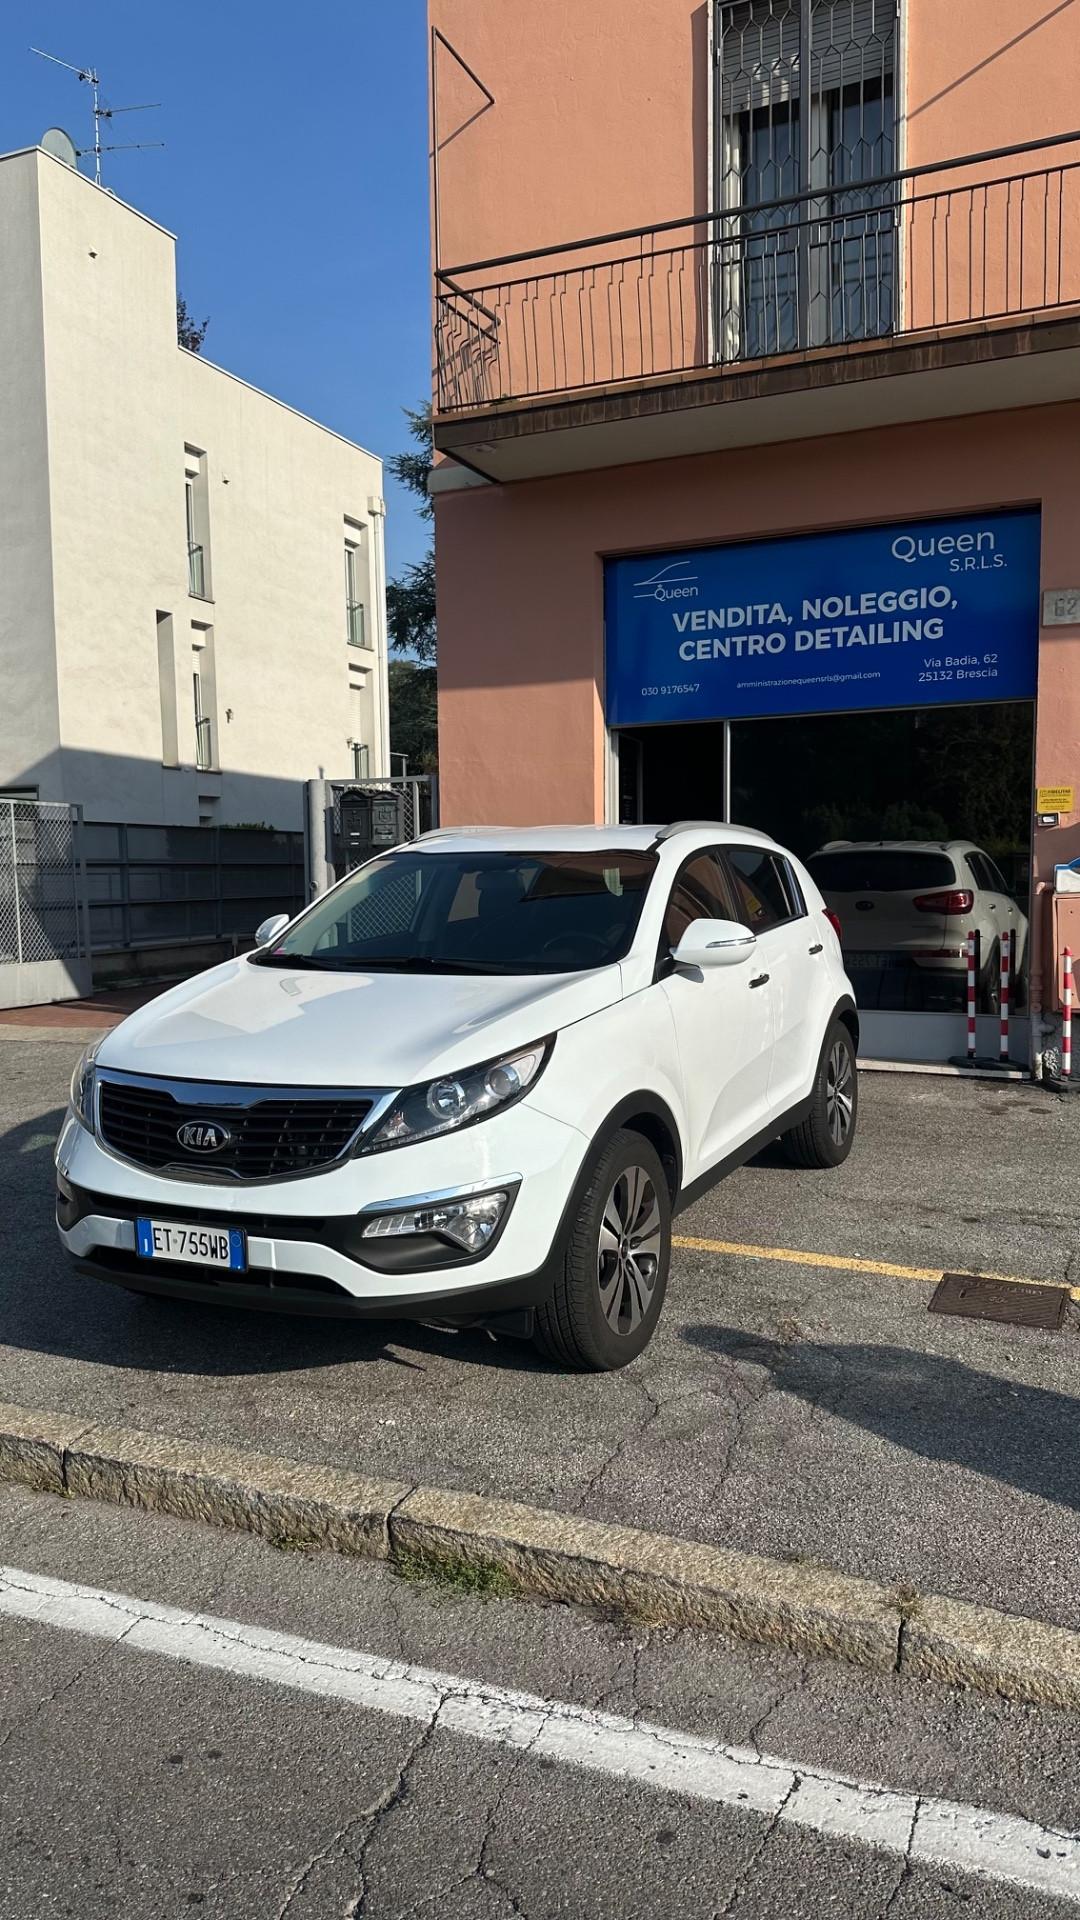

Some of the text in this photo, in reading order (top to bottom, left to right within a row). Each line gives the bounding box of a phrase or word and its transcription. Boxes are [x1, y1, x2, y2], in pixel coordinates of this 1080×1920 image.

[891, 531, 995, 563] Queen
[949, 554, 1008, 572] S.R.L.S.
[655, 586, 699, 602] Queen
[672, 585, 958, 633] VENDITA, NOLEGGIO,
[679, 618, 944, 661] CENTRO DETAILING
[924, 653, 998, 668] Via Badia, 62
[918, 667, 998, 682] 25132 Brescia
[641, 683, 700, 696] 030 9176547
[183, 1126, 217, 1147] KIA
